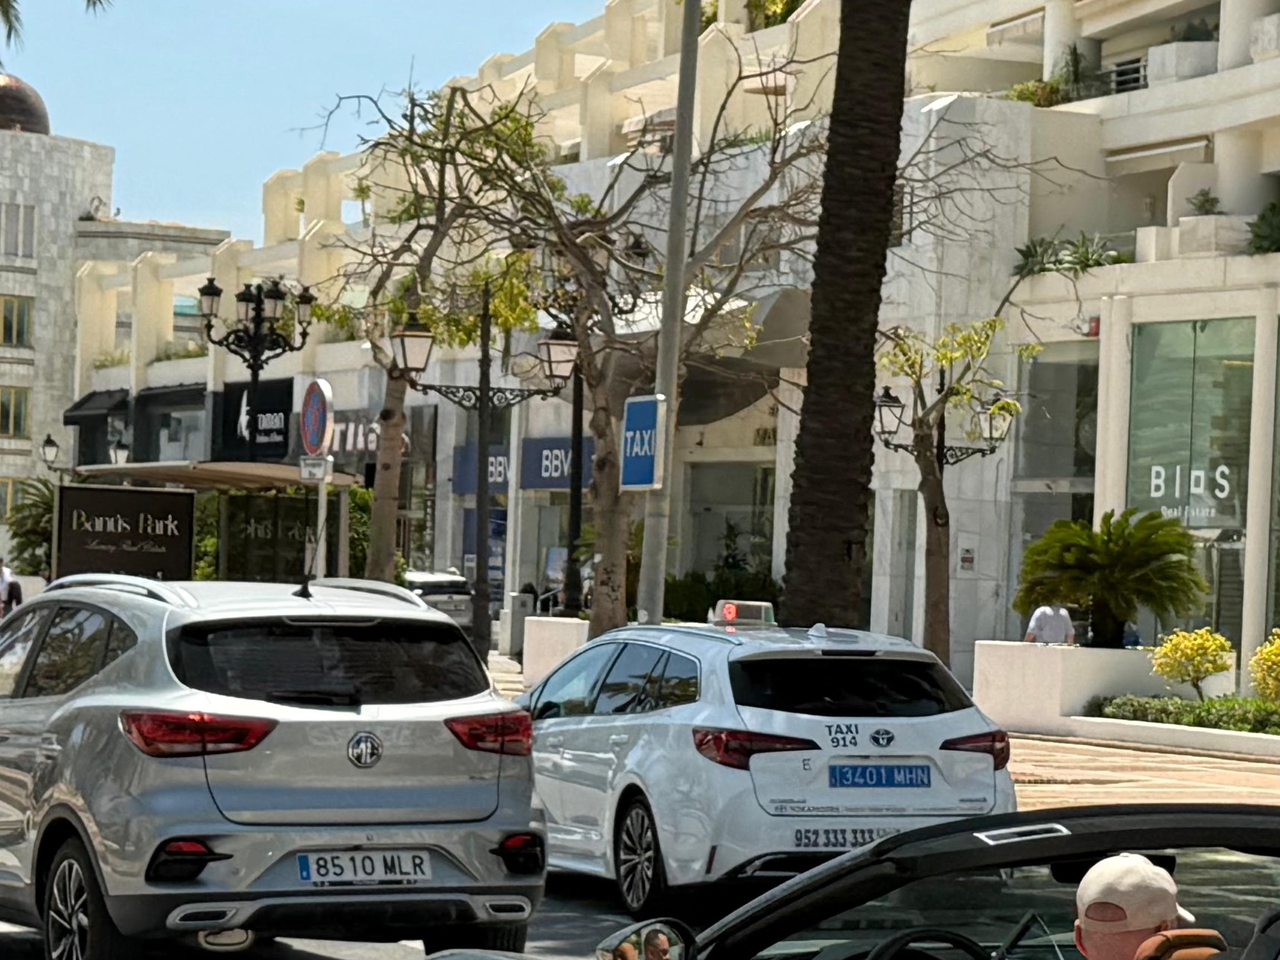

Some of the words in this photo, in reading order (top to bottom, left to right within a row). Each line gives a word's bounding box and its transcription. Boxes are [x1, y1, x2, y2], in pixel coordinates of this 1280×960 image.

[625, 429, 656, 457] TAXI
[541, 449, 572, 478] BBV
[825, 723, 859, 736] TAXI
[830, 736, 858, 748] 914
[842, 767, 887, 785] 3401
[894, 767, 929, 785] MHN
[795, 828, 820, 847] 952
[823, 828, 848, 848] 333
[851, 828, 875, 848] 333
[315, 855, 376, 877] 8510
[383, 854, 427, 877] MLR
